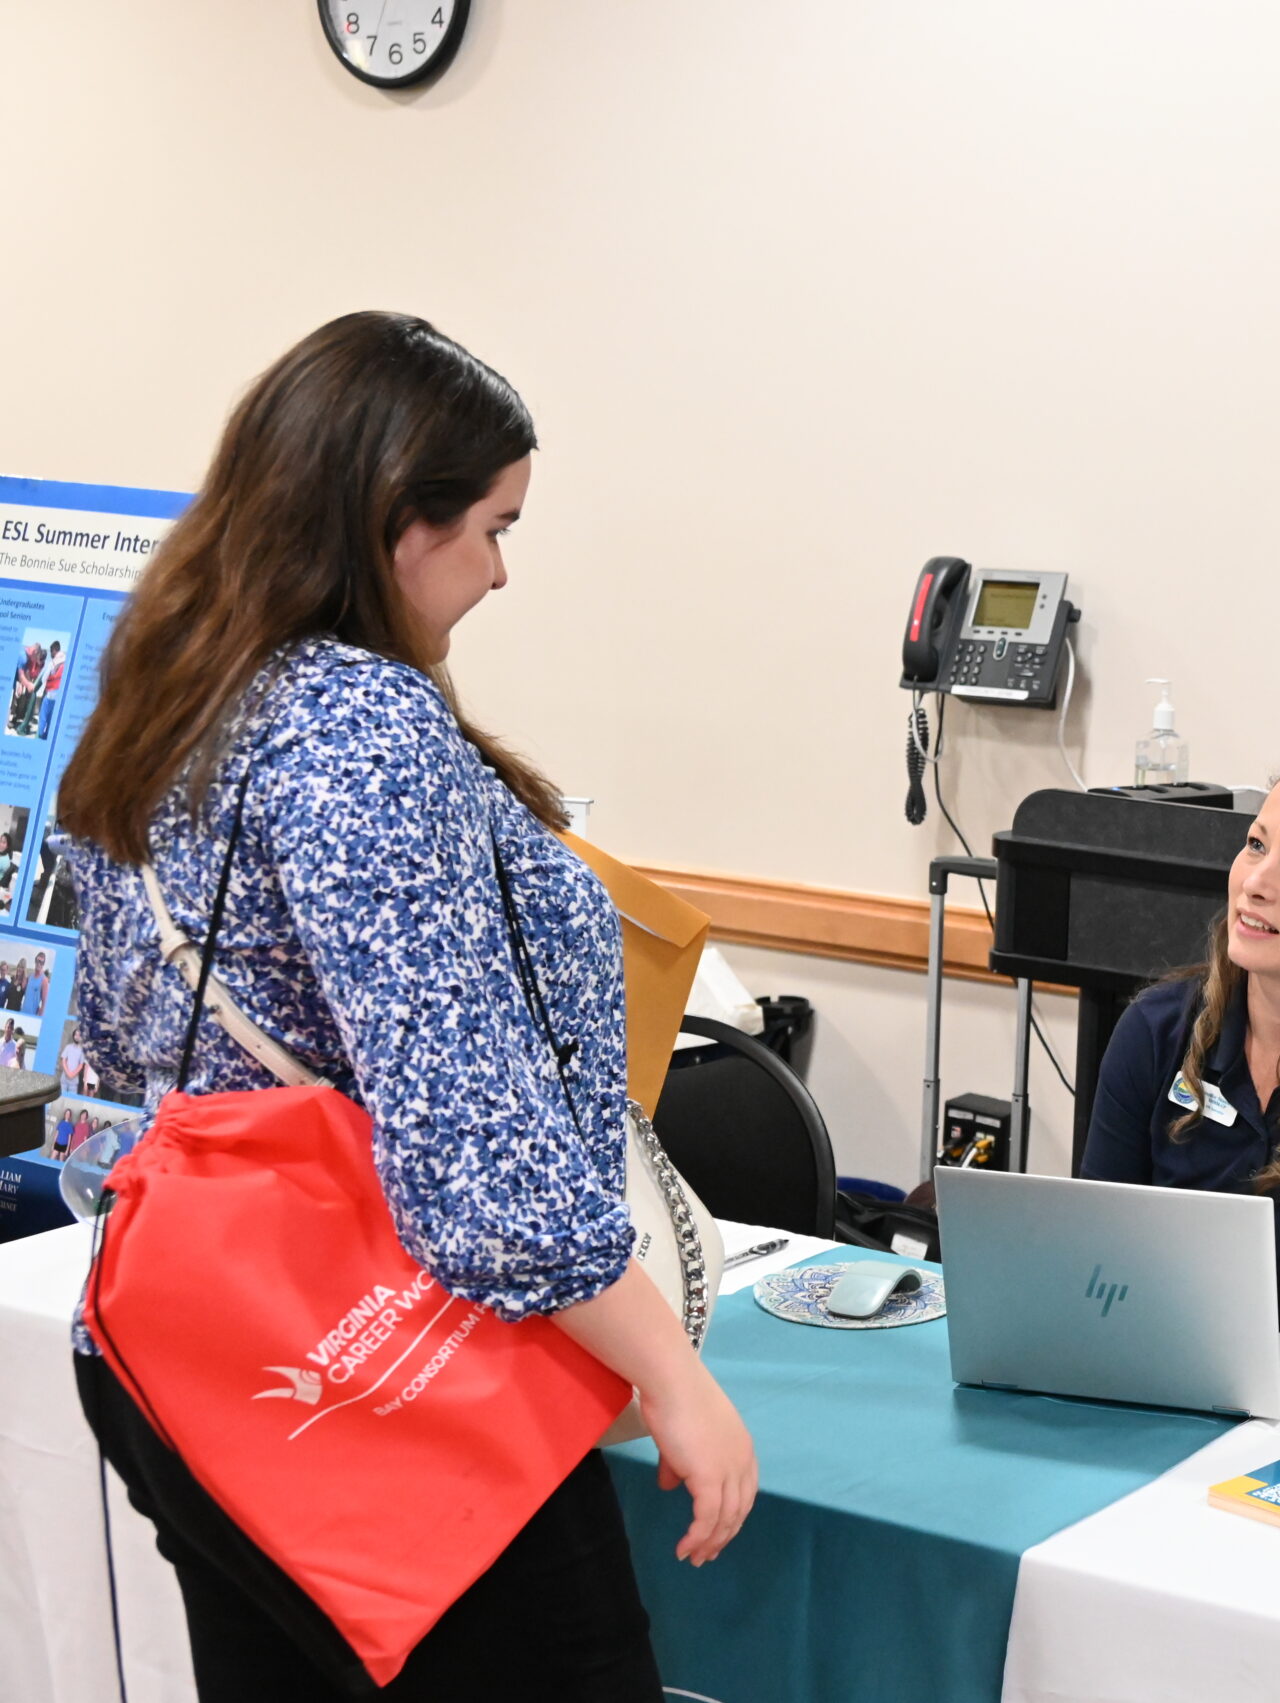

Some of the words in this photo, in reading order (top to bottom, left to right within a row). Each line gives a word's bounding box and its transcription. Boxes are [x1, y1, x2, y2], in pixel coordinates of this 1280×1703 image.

[346, 12, 360, 35] 8
[431, 6, 446, 28] 4
[366, 35, 378, 57] 7
[388, 43, 403, 65] 6
[412, 32, 426, 55] 5
[2, 520, 29, 541] ESL
[35, 523, 109, 550] Summer
[20, 555, 56, 571] Bonnie
[58, 558, 78, 573] Sue
[306, 1284, 397, 1367] VIRGINIA
[327, 1307, 403, 1384] CAREER
[372, 1396, 403, 1416] BAY
[401, 1313, 480, 1401] CONSORTIUM
